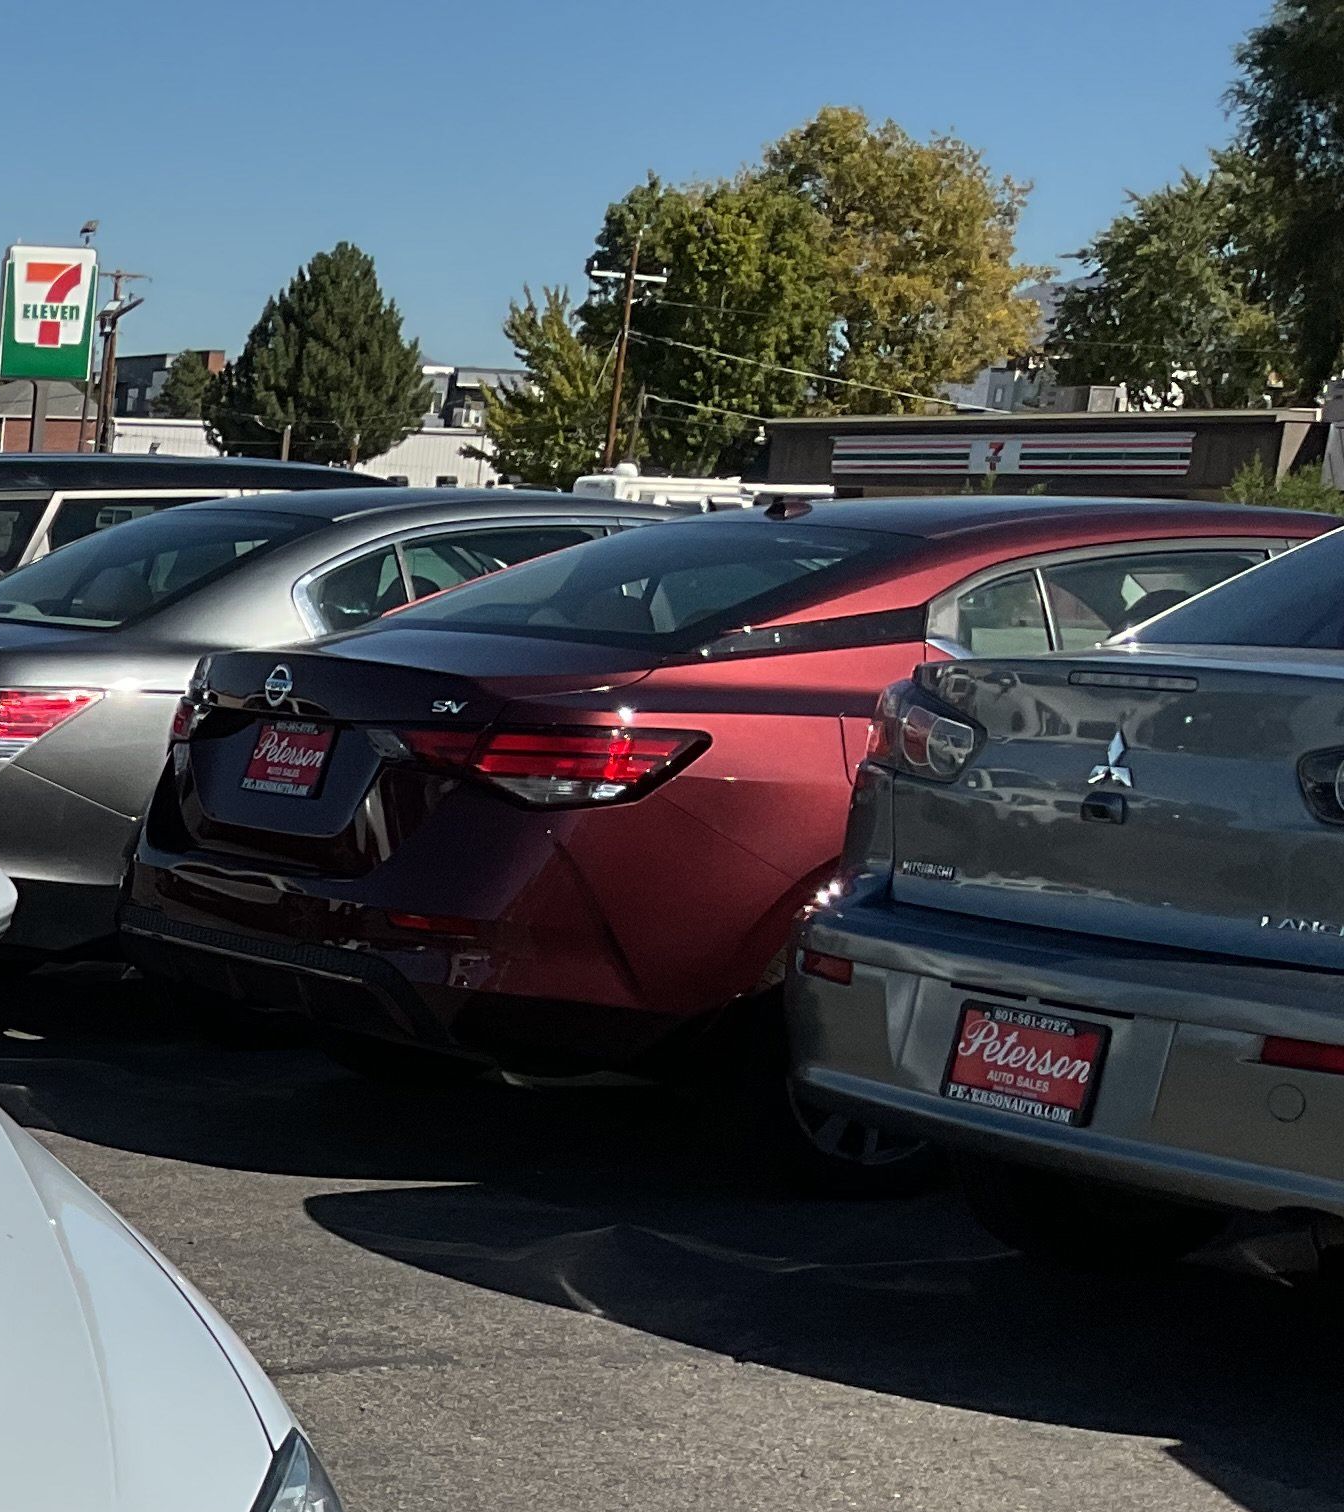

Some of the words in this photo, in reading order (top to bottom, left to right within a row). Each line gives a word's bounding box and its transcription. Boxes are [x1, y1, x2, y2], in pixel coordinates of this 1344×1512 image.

[432, 700, 469, 714] SV
[253, 731, 325, 768] Peterson
[1260, 915, 1344, 937] LANC
[958, 1019, 1091, 1084] Peterson
[987, 1069, 1015, 1085] AUTO
[1016, 1076, 1050, 1093] SALES
